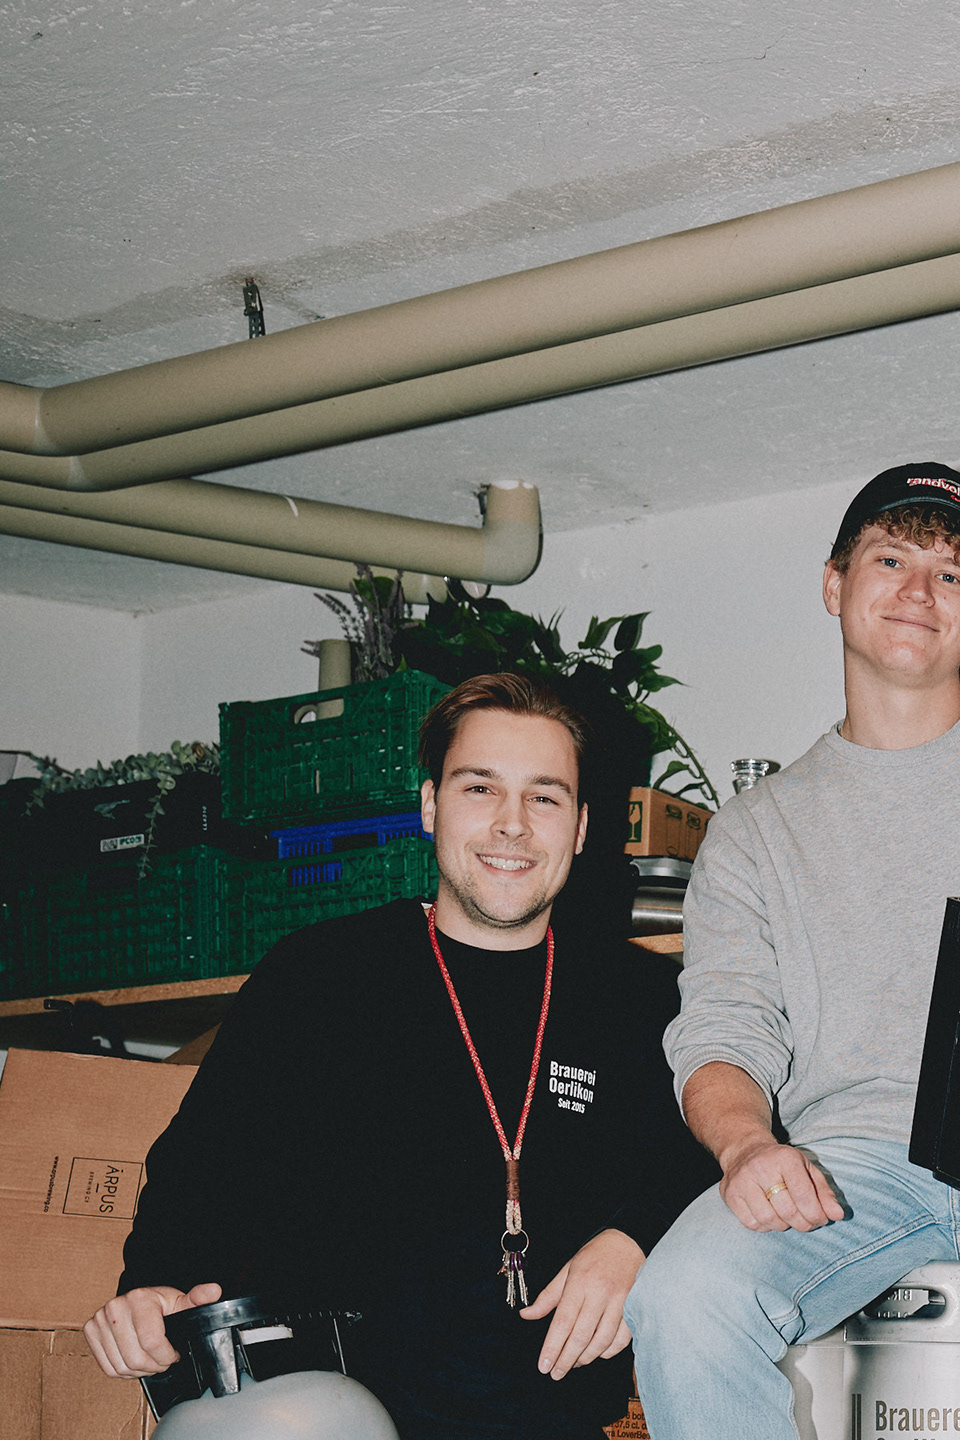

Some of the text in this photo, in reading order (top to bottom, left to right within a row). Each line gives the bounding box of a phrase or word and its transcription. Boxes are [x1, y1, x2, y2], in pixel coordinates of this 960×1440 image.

[550, 1060, 597, 1086] Brauerei
[549, 1077, 594, 1103] Oerlikon
[557, 1098, 586, 1114] Seit 2015
